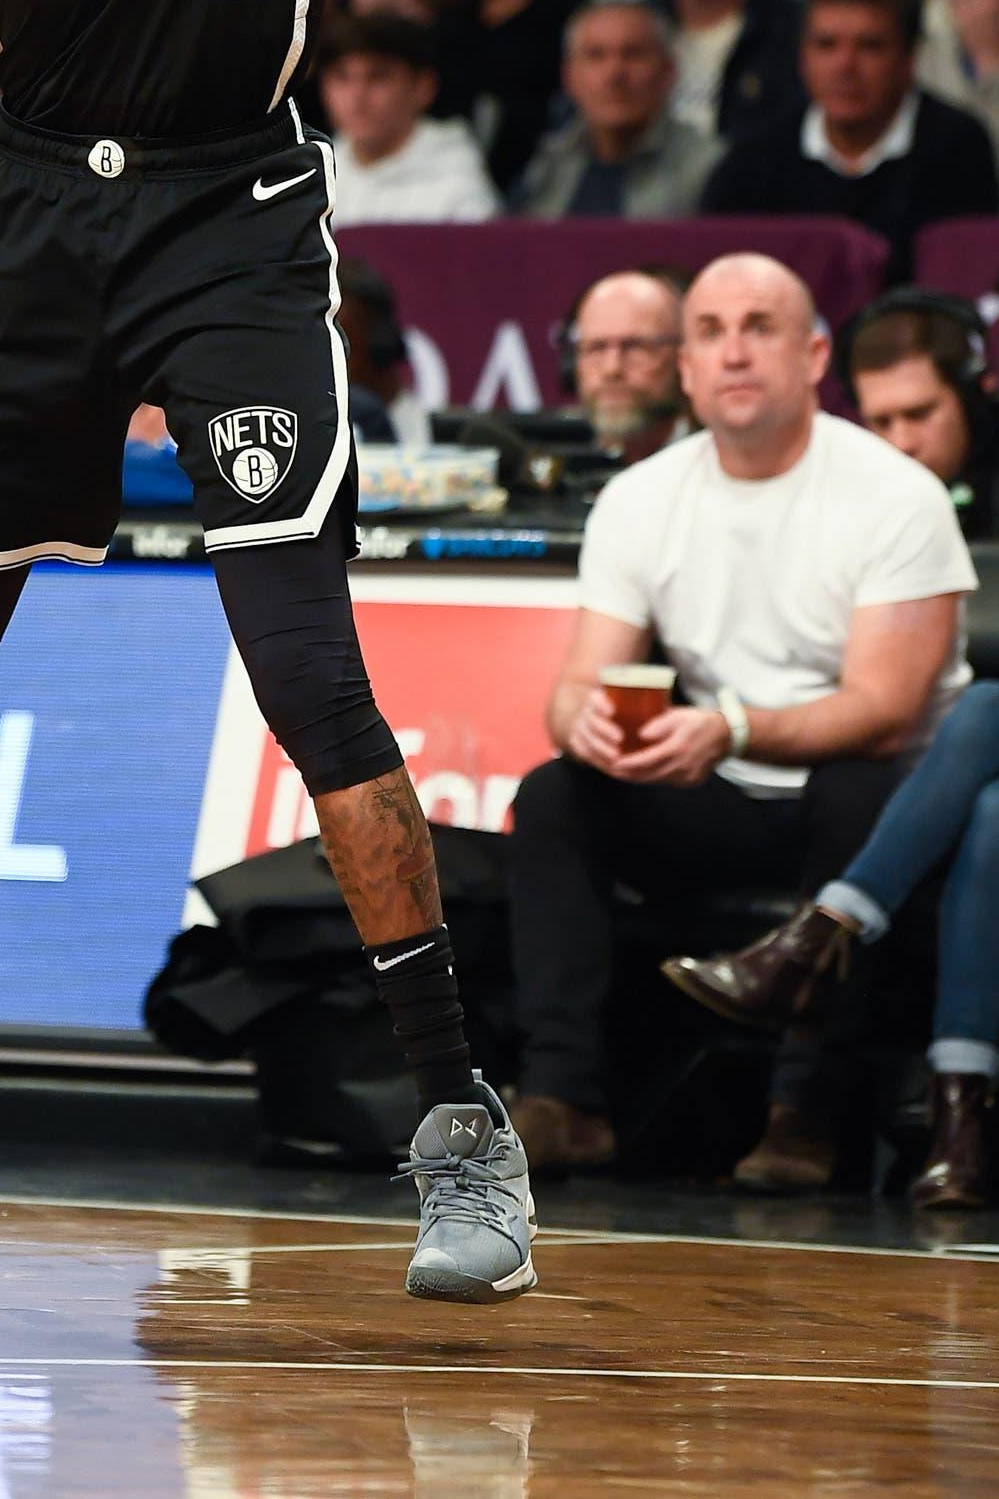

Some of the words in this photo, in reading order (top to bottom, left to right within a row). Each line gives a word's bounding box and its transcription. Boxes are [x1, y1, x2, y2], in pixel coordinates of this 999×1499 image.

[101, 146, 112, 173] B
[214, 411, 293, 457] NETS
[248, 455, 263, 488] B
